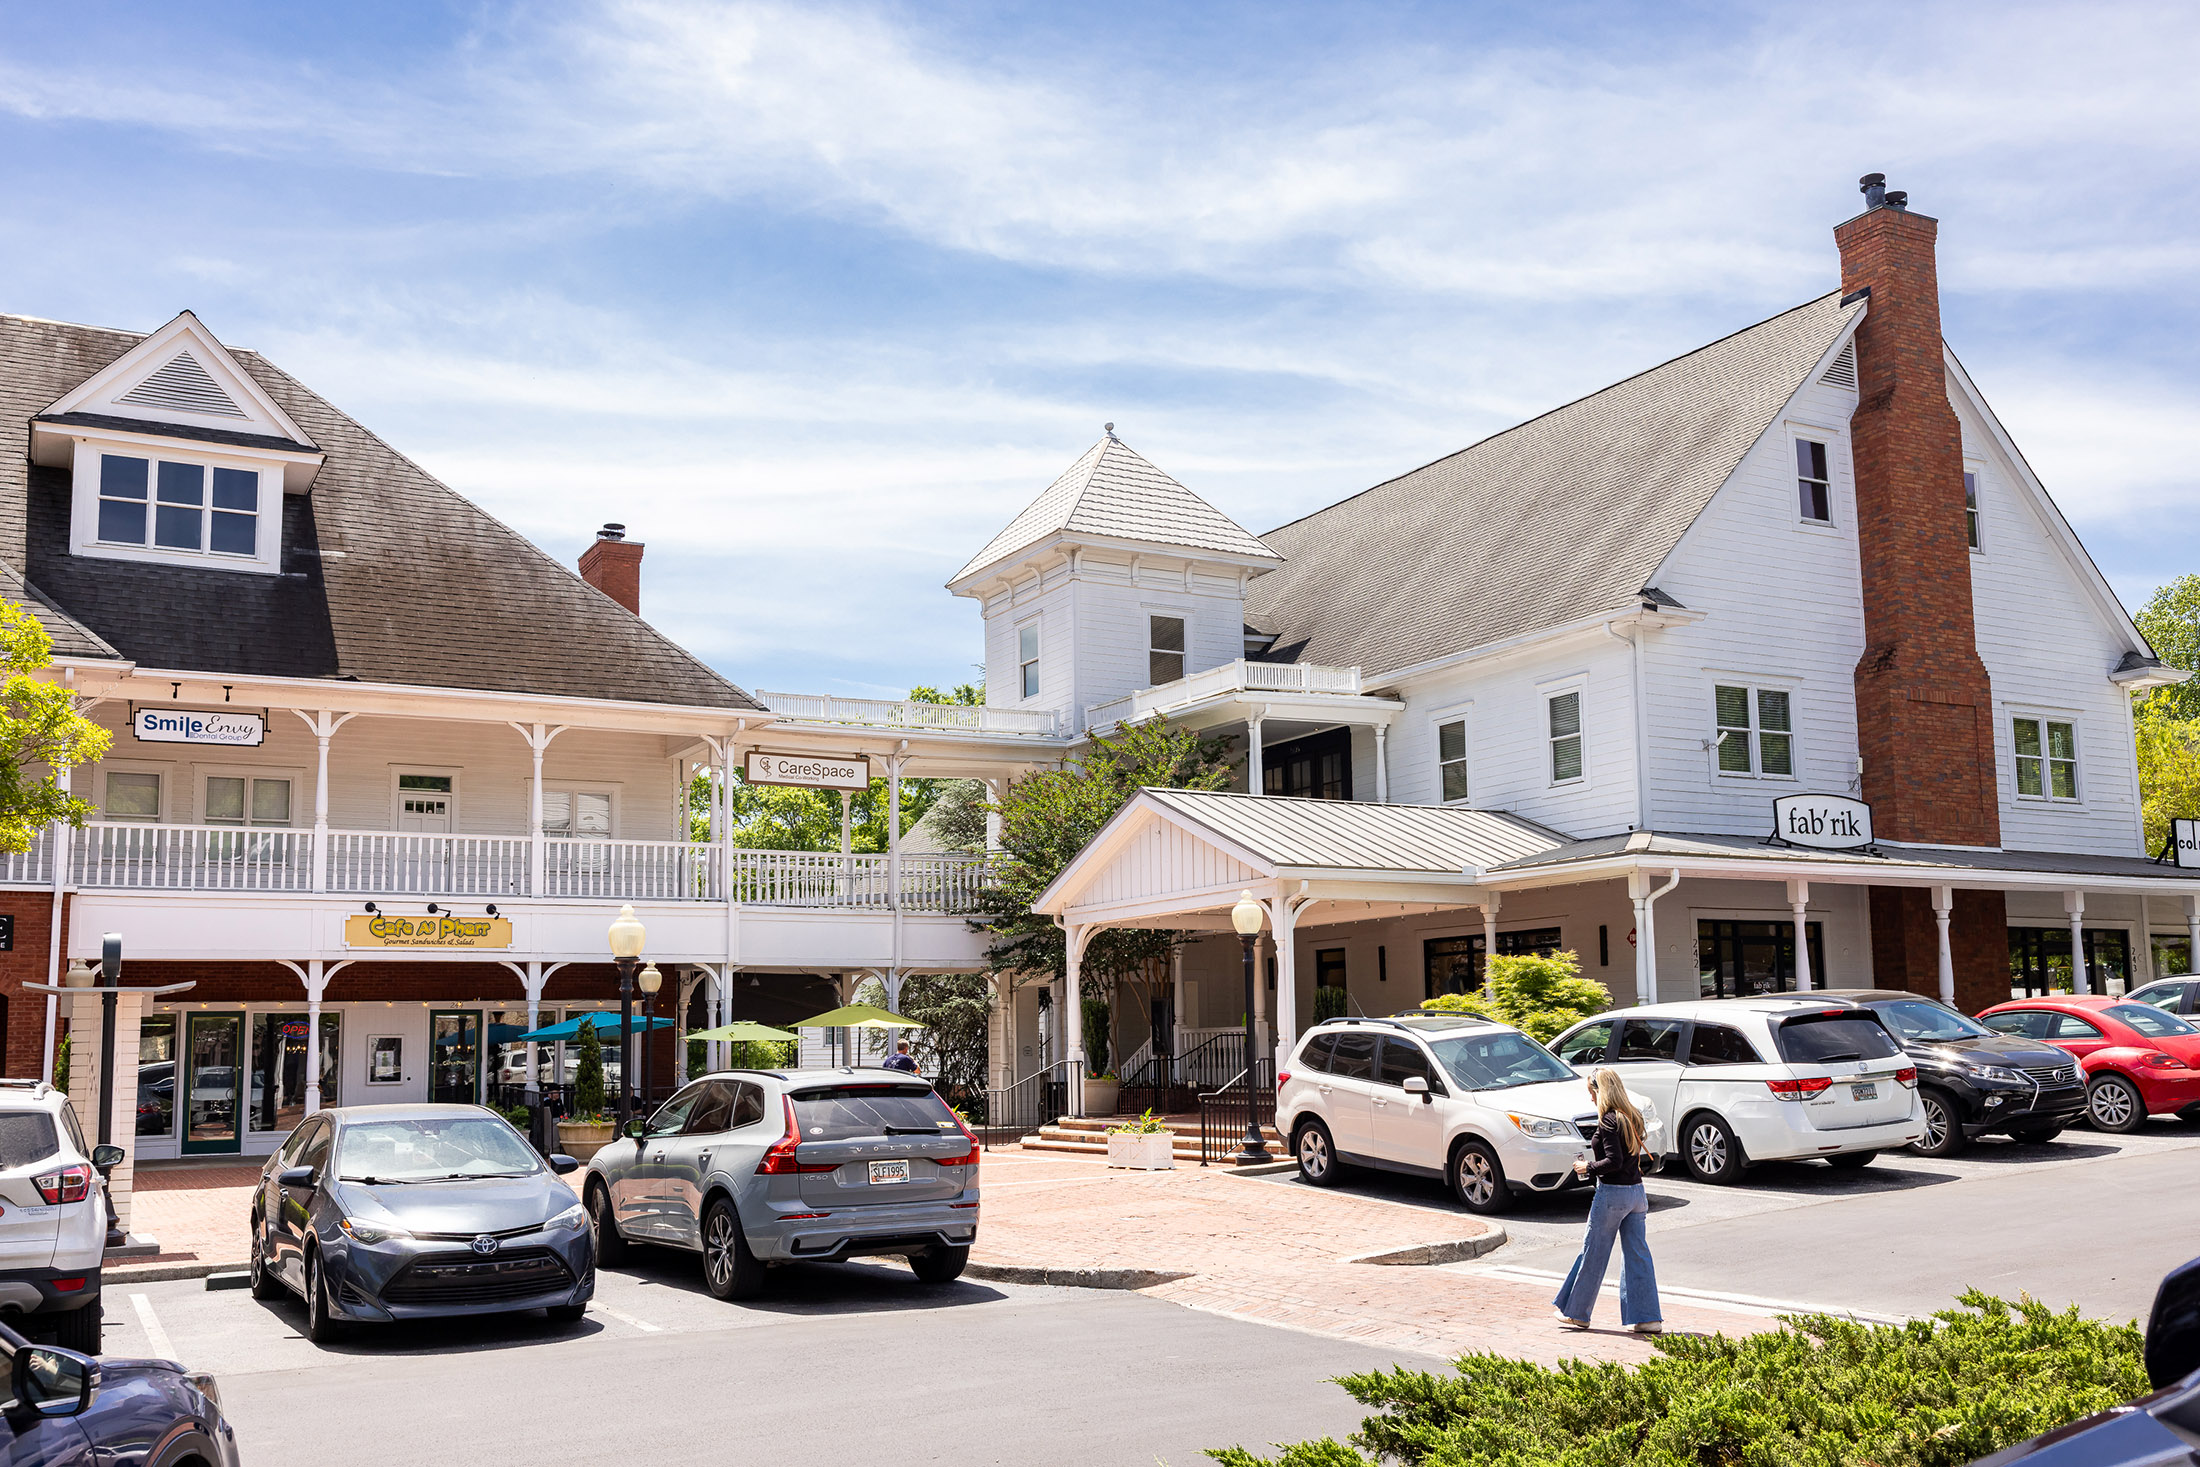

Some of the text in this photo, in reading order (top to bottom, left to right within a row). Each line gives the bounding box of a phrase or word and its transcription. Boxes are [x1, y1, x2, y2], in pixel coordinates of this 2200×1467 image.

[144, 714, 255, 739] Smile Envy
[193, 732, 243, 742] Dental Group
[778, 760, 855, 779] CareSpace
[1789, 807, 1862, 837] fab'rik
[369, 917, 414, 938] Cafe
[439, 918, 491, 939] Pharr
[383, 938, 410, 946] Gourmet
[410, 938, 446, 946] Sandwiches
[856, 1144, 927, 1153] VOLVO
